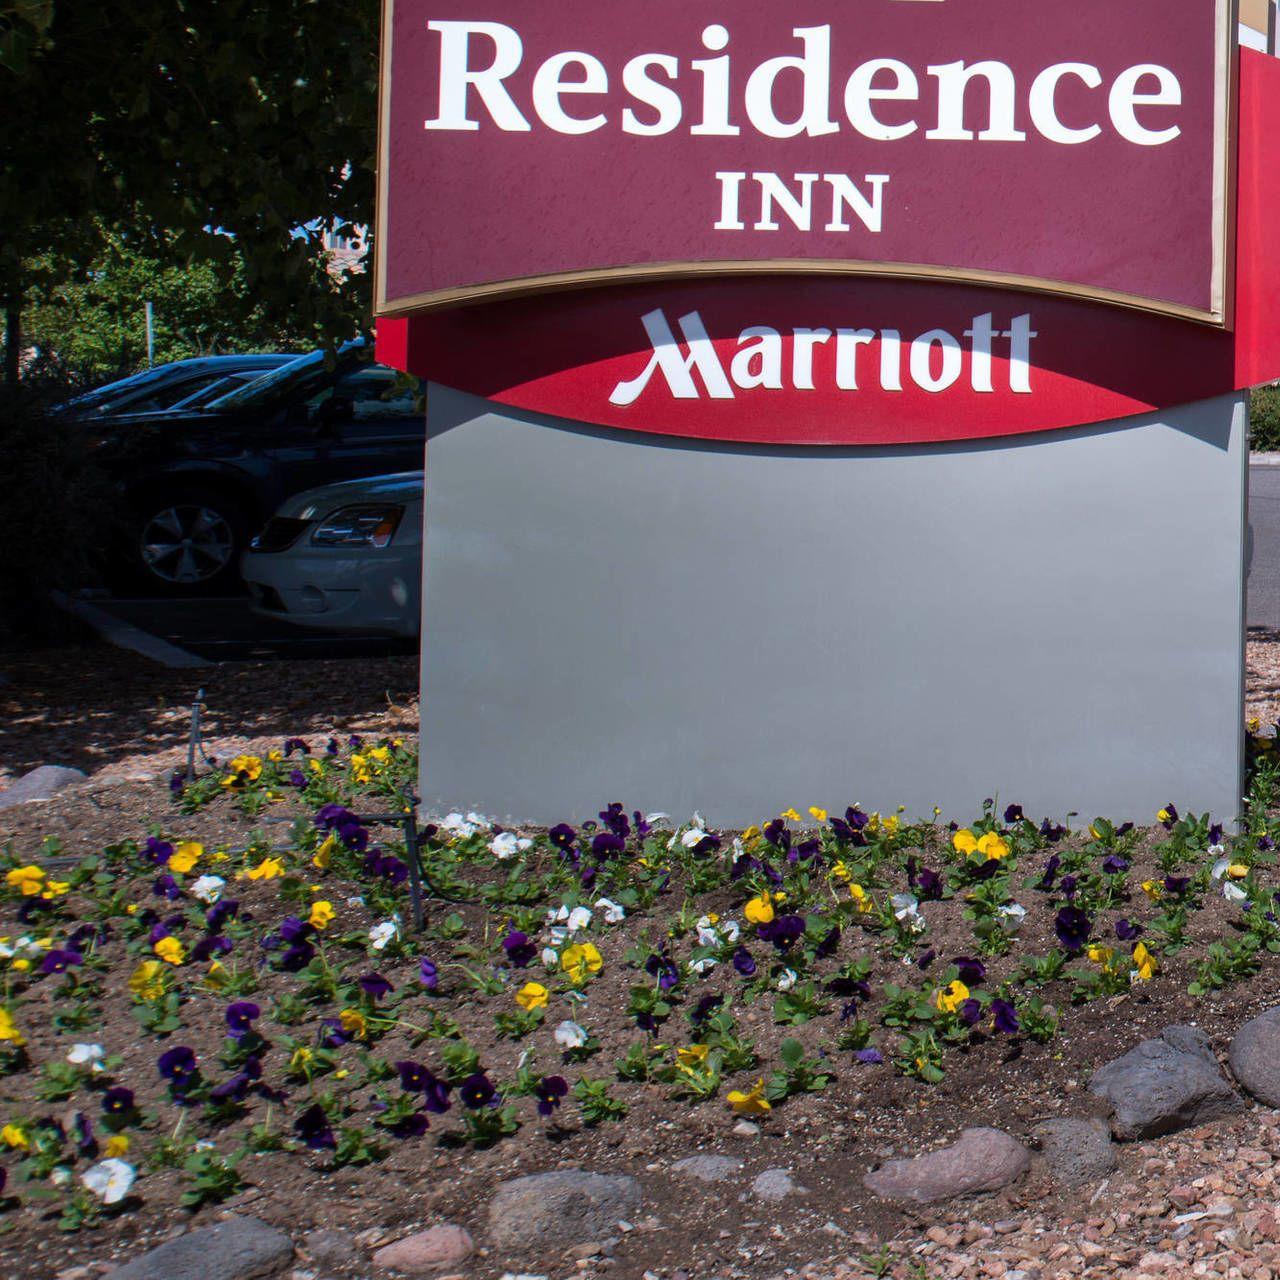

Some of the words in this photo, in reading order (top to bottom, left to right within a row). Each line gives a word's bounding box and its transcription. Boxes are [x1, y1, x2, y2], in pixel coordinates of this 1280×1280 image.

[425, 20, 1182, 145] Residence
[714, 171, 890, 233] INN
[608, 308, 1038, 407] Marriott
